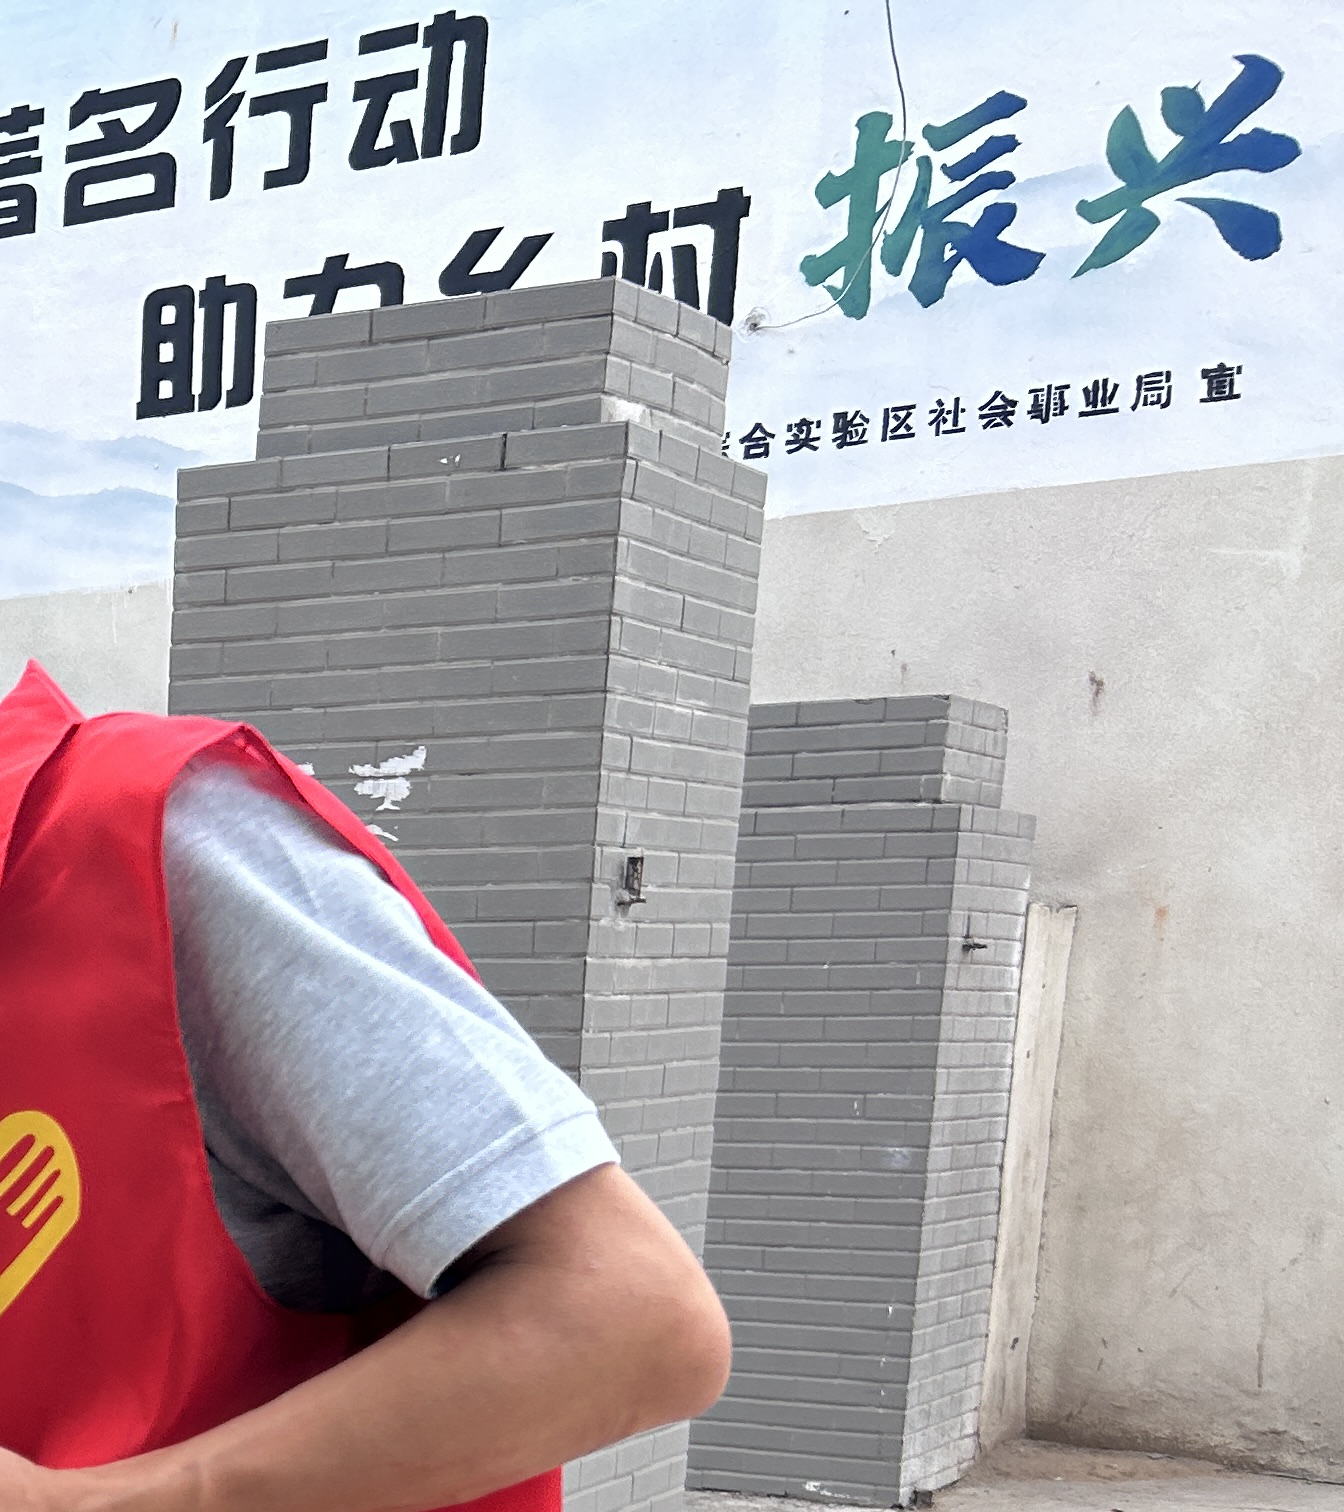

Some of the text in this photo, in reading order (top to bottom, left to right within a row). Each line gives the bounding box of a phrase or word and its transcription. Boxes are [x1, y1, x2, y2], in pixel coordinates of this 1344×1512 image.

[721, 370, 1172, 460] 合实验区社会事业局
